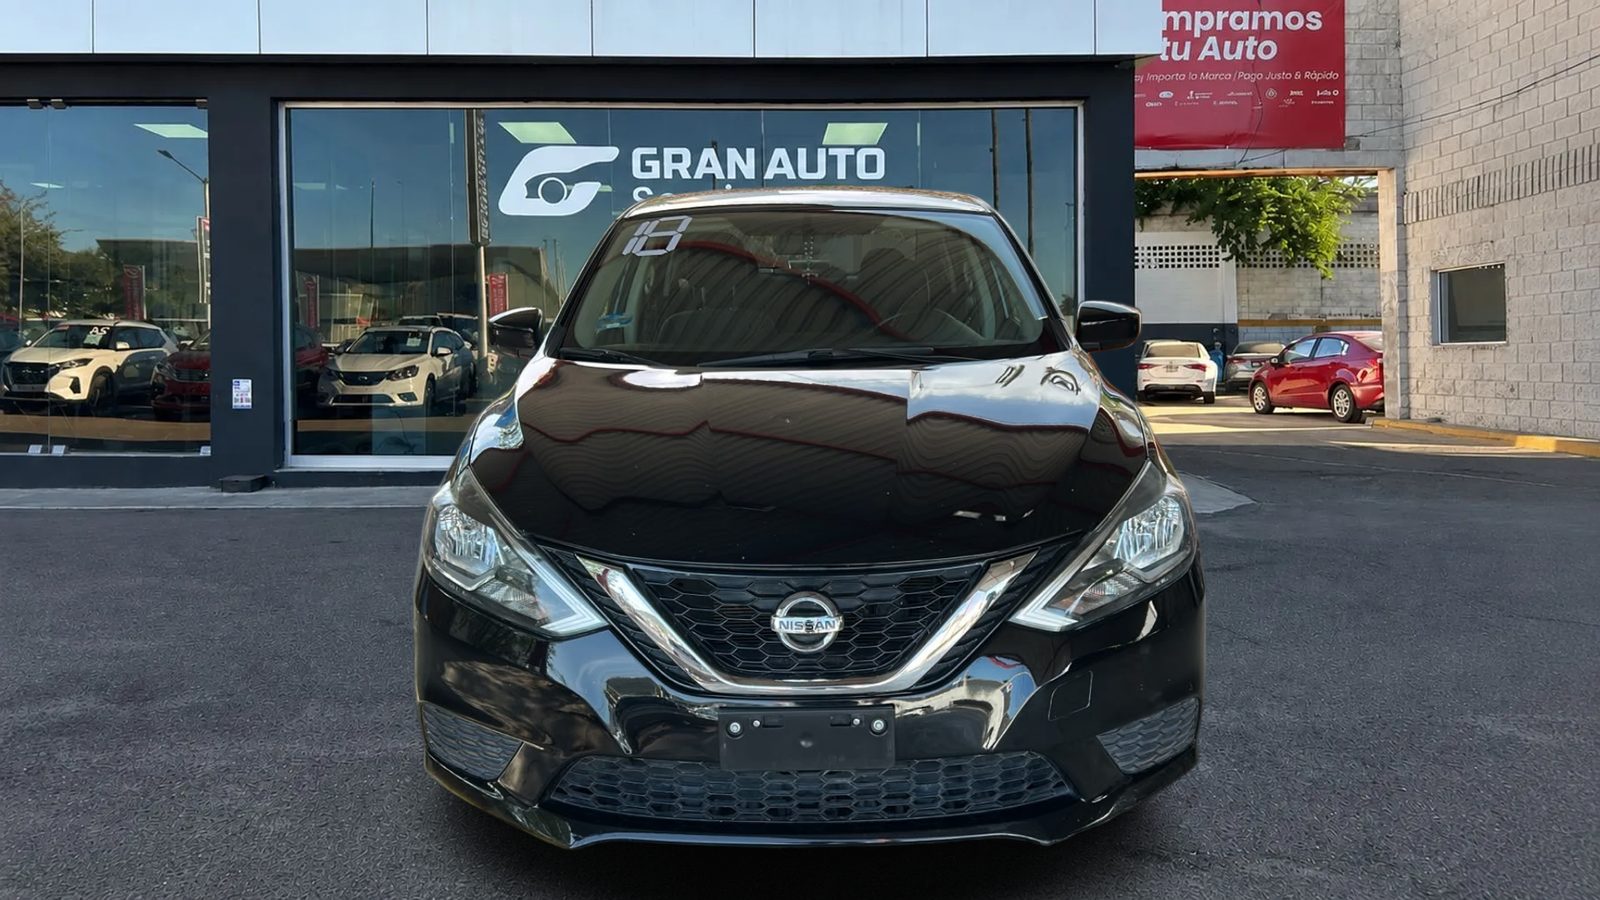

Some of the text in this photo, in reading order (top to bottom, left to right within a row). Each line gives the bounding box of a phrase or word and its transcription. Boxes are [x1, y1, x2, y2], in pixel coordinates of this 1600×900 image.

[1160, 36, 1277, 61] tu Auto
[1146, 73, 1186, 83] Importa
[1188, 72, 1198, 80] la
[1199, 72, 1232, 80] Marca
[1265, 72, 1293, 80] Justo
[1294, 72, 1301, 80] &
[631, 147, 886, 180] GRAN AUTO
[622, 215, 693, 257] 18
[779, 620, 836, 632] NISSAN
